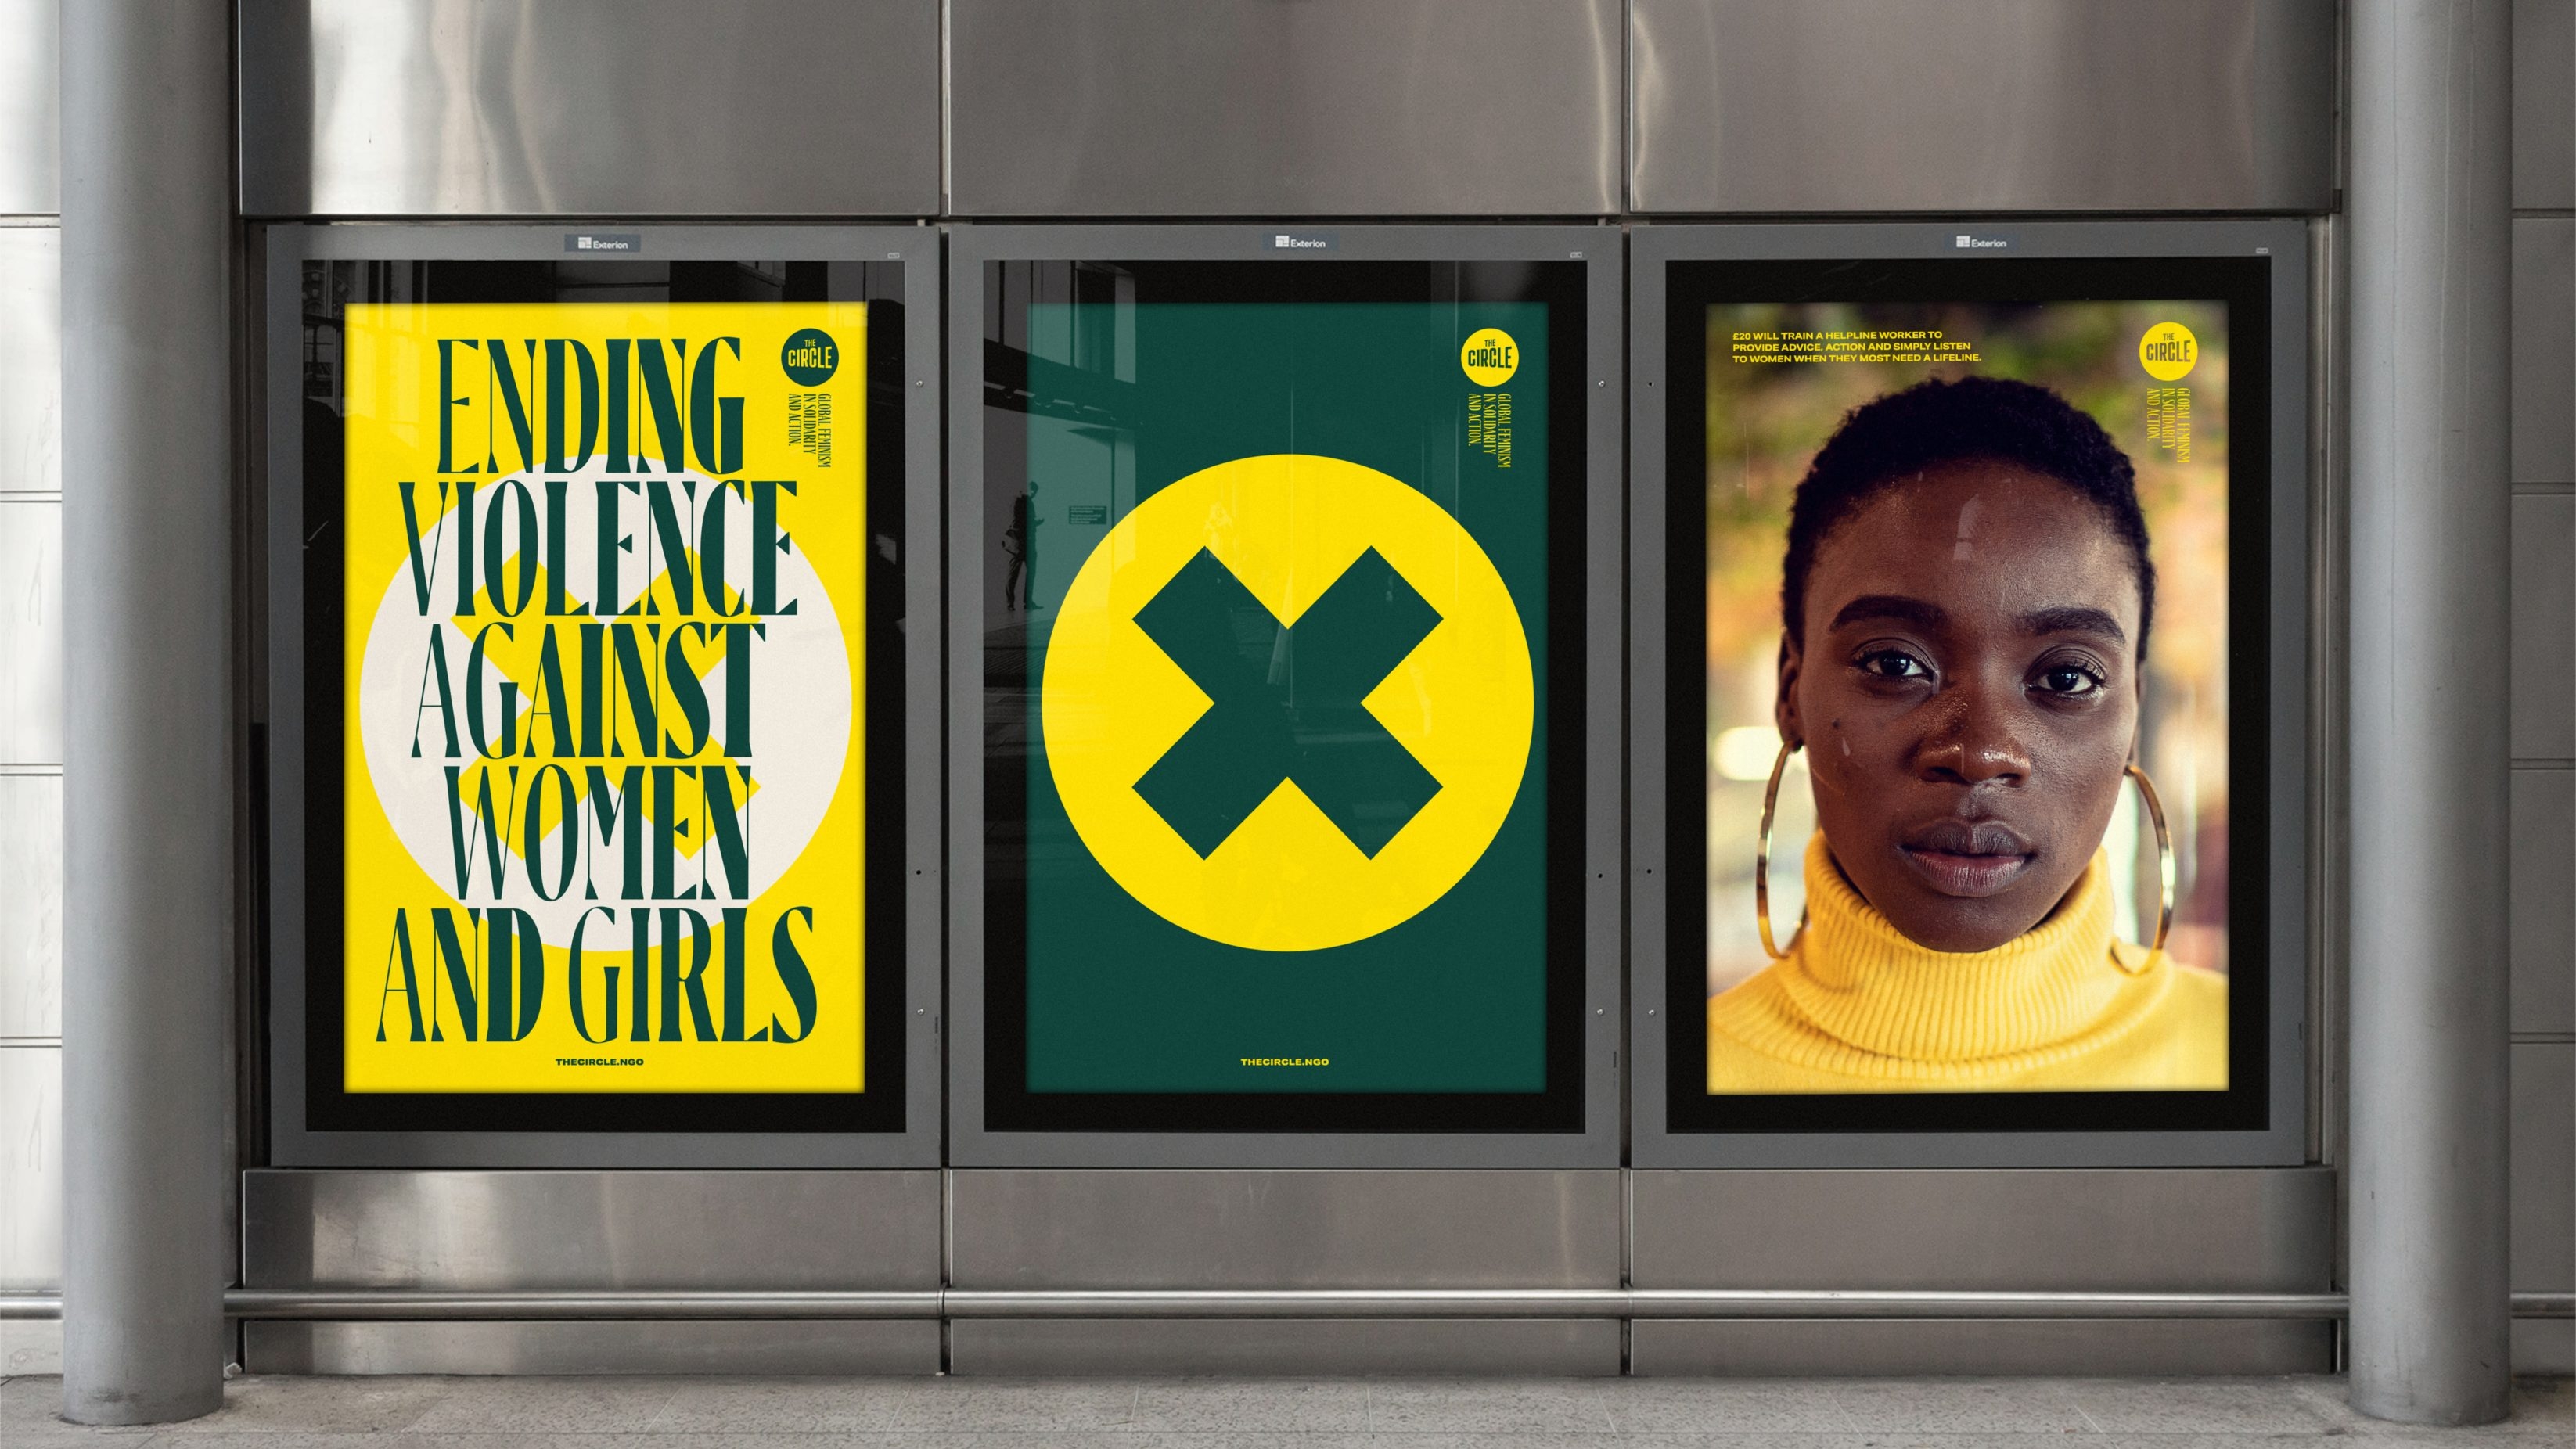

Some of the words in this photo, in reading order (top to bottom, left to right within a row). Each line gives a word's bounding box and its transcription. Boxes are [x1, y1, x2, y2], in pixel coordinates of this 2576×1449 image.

[593, 240, 628, 250] Exterion
[1290, 239, 1326, 248] Exterion
[1971, 239, 2007, 248] Exterion
[788, 347, 832, 369] CIRCLE
[1468, 347, 1512, 369] CIRCLE
[2146, 340, 2190, 362] CIRCLE
[437, 337, 744, 474] ENDING
[789, 394, 801, 411] AND
[803, 394, 816, 402] IN
[1468, 394, 1481, 411] AND
[1483, 394, 1496, 402] IN
[2147, 388, 2160, 405] AND
[2162, 388, 2175, 397] IN
[2177, 387, 2190, 420] GLOBAL
[818, 394, 831, 426] GLOBAL
[1498, 394, 1511, 426] GLOBAL
[2147, 408, 2160, 441] ACTION.
[2162, 399, 2175, 449] SOLIDARITY
[789, 413, 801, 446] ACTION.
[803, 404, 816, 454] SOLIDARITY
[1468, 413, 1481, 446] ACTION.
[1483, 404, 1496, 454] SOLIDARITY
[2177, 422, 2190, 462] FEMINISM
[818, 428, 831, 467] FEMINISM
[1498, 428, 1511, 467] FEMINISM
[399, 480, 797, 617] VIOLENCE
[411, 622, 766, 760] AGAINST
[444, 764, 752, 901] WOMEN
[376, 907, 545, 1043] AND
[568, 906, 818, 1044] GIRLS
[555, 1058, 645, 1066] THECIRCLE.NGO
[1240, 1058, 1329, 1066] THECIRCLE.NGO
